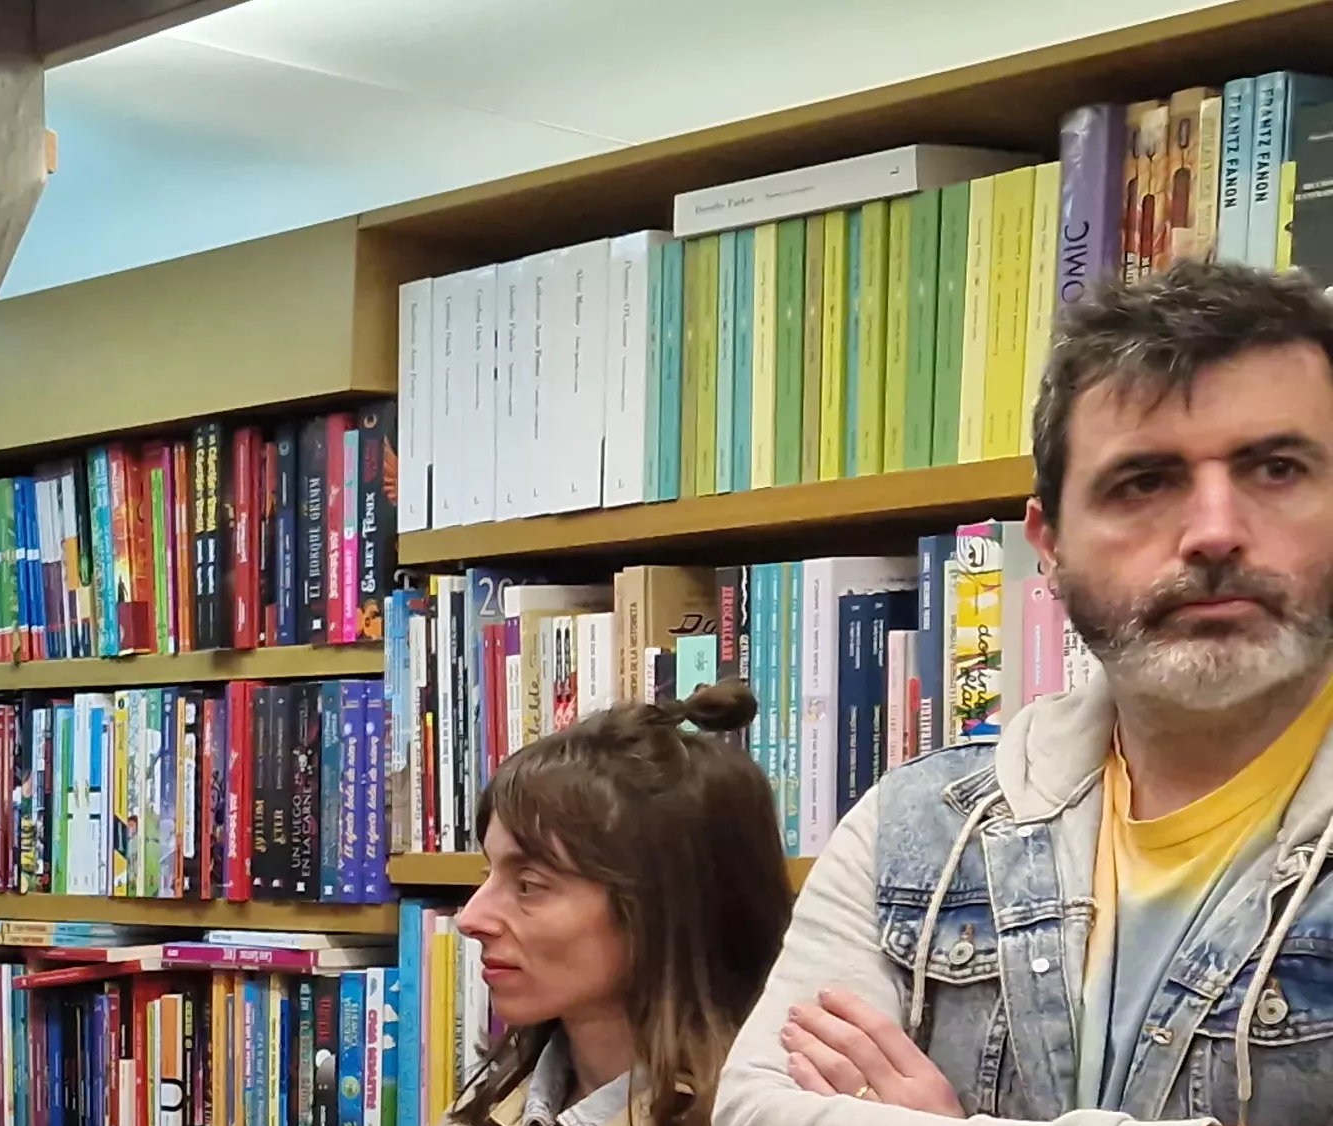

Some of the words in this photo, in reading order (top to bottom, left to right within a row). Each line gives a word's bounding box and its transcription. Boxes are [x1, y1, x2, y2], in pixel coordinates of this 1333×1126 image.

[1223, 158, 1238, 208] FANON
[1255, 151, 1270, 202] FANON
[1061, 221, 1090, 304] OMIC
[308, 478, 320, 520] GRIMM
[363, 540, 375, 568] REY
[309, 583, 321, 598] EL
[292, 794, 302, 842] FUEGO
[301, 787, 312, 834] CARNE
[292, 845, 302, 868] UN
[302, 835, 311, 852] LA
[301, 853, 311, 877] EN
